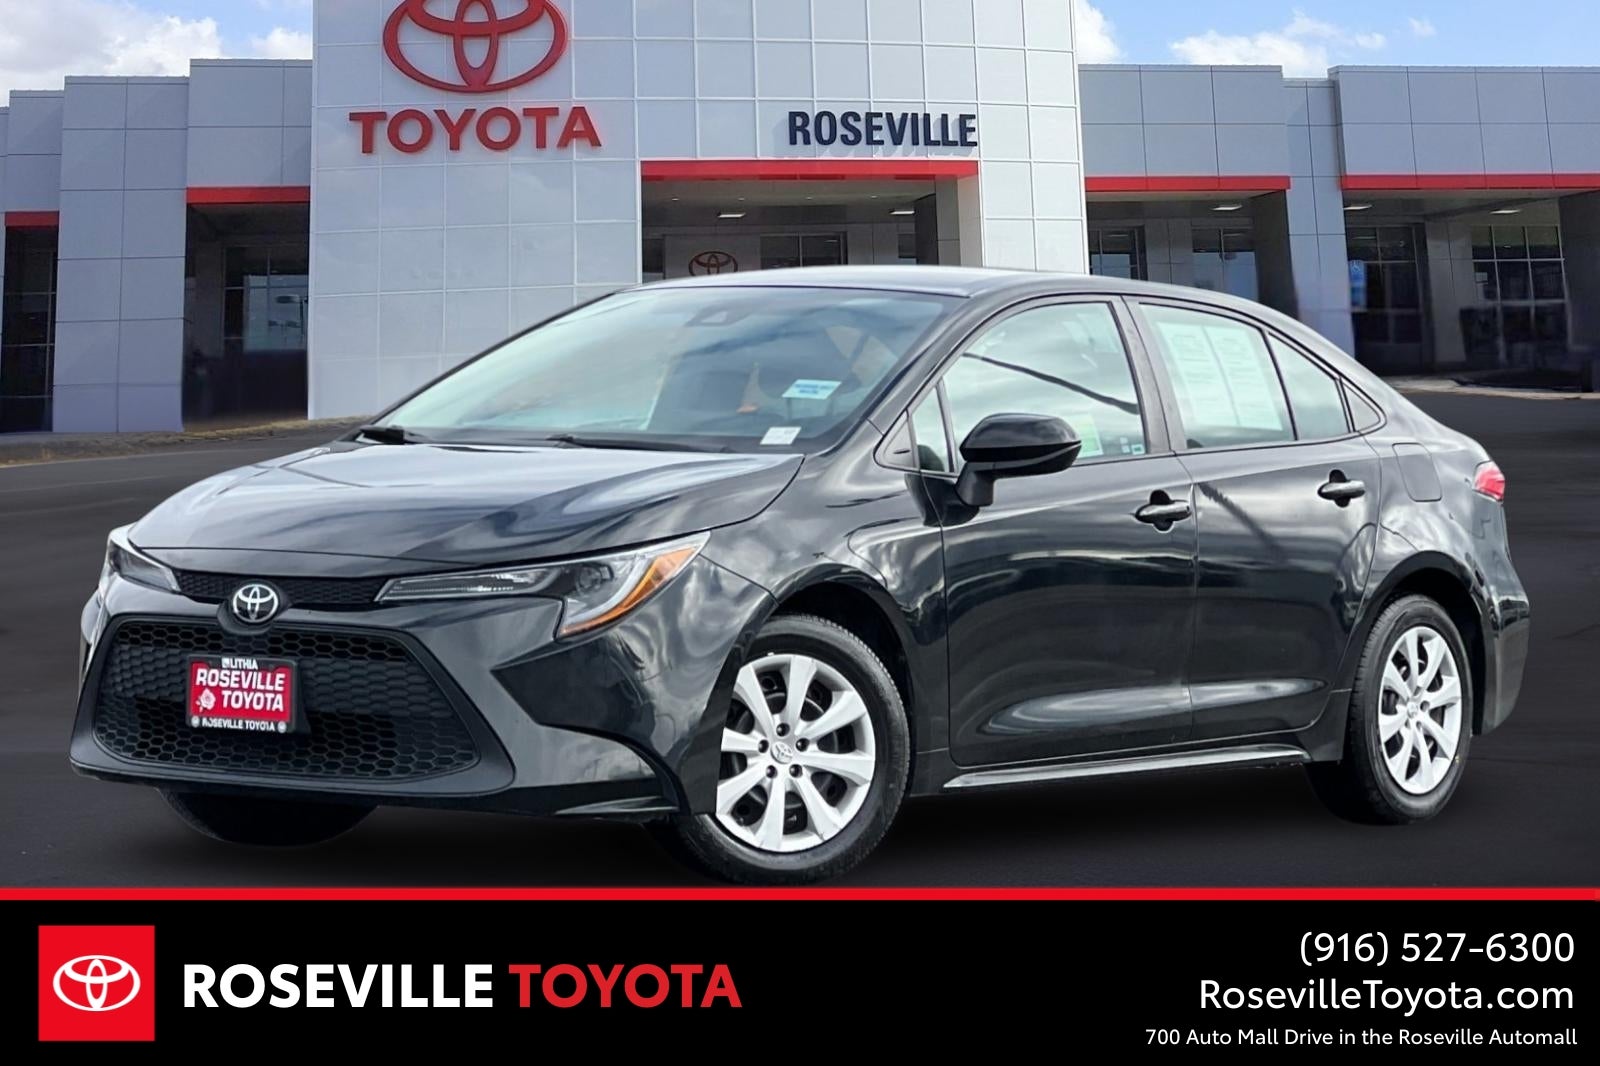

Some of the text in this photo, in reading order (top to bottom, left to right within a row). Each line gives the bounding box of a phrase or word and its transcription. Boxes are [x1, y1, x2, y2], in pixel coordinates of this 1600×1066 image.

[349, 106, 602, 154] TOYOTA
[788, 110, 978, 148] ROSEVILLE
[230, 657, 259, 671] LITHIA
[195, 668, 286, 691] ROSEVILLE
[221, 690, 284, 712] TOYOTA
